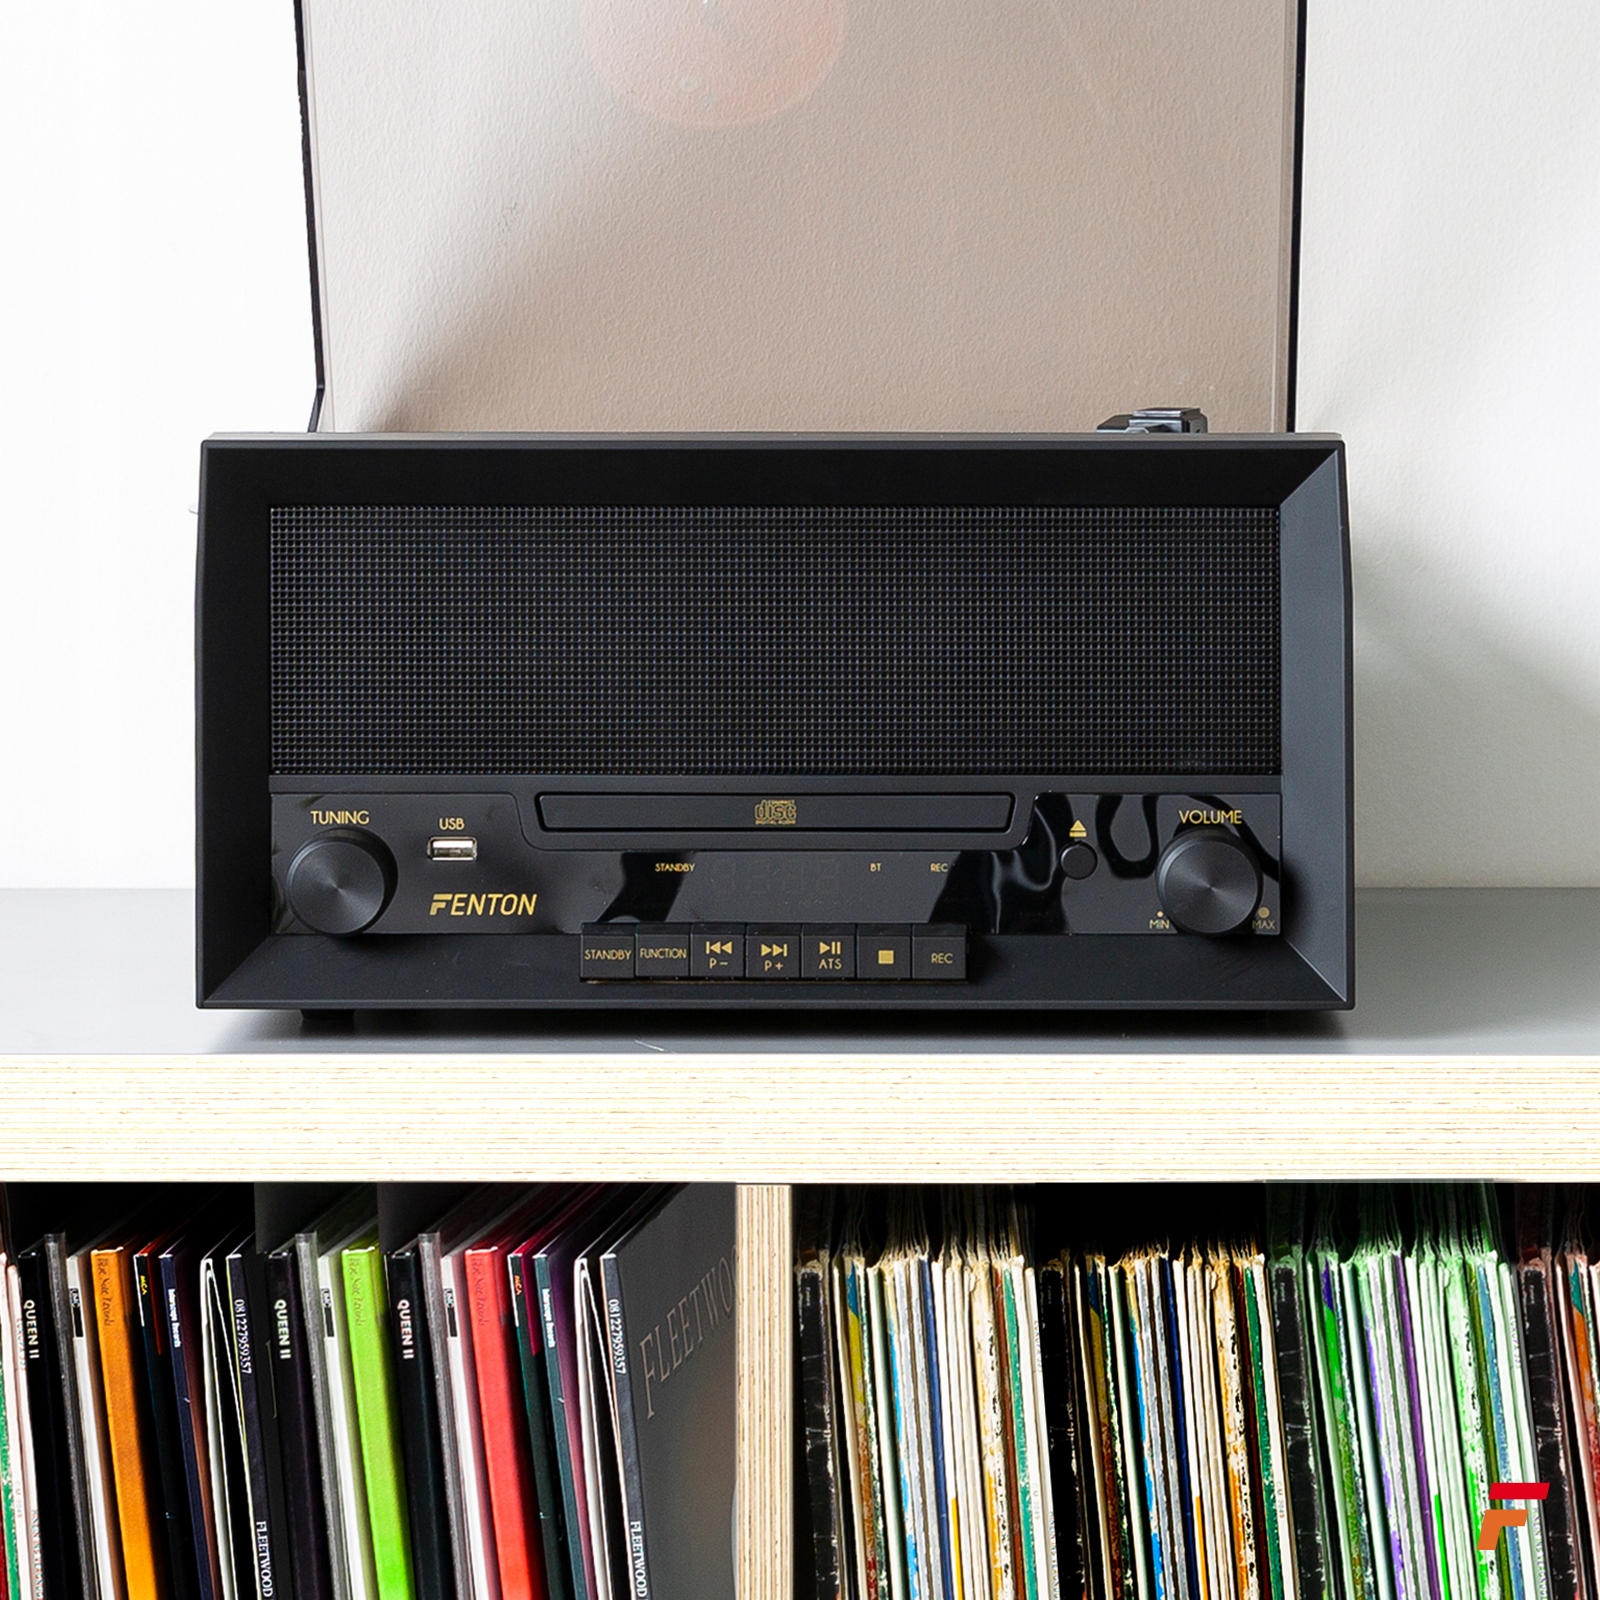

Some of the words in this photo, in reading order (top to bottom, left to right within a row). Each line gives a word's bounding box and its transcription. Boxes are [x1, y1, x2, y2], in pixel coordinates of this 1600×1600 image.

[310, 810, 370, 825] TUNING
[1178, 809, 1243, 825] VOLUME
[439, 817, 465, 831] USB
[654, 862, 696, 873] STANDBY
[869, 862, 882, 873] BT
[930, 862, 949, 873] REC
[429, 893, 538, 916] FENTON
[1149, 919, 1170, 930] MIN
[1251, 919, 1276, 930] MAX
[583, 949, 632, 961] STANDBY
[639, 947, 688, 960] FUNCTION
[930, 952, 954, 965] REC
[818, 957, 842, 970] ATS
[23, 1299, 39, 1346] QUEEN
[274, 1299, 290, 1346] QUEEN
[397, 1299, 413, 1346] QUEEN
[234, 1298, 253, 1375] 081227959357
[608, 1298, 627, 1375] 081227959357
[28, 1348, 40, 1360] II
[280, 1348, 291, 1360] II
[403, 1348, 415, 1360] II
[255, 1520, 273, 1598] FLEETWOOD
[630, 1520, 648, 1598] FLEETWOOD
